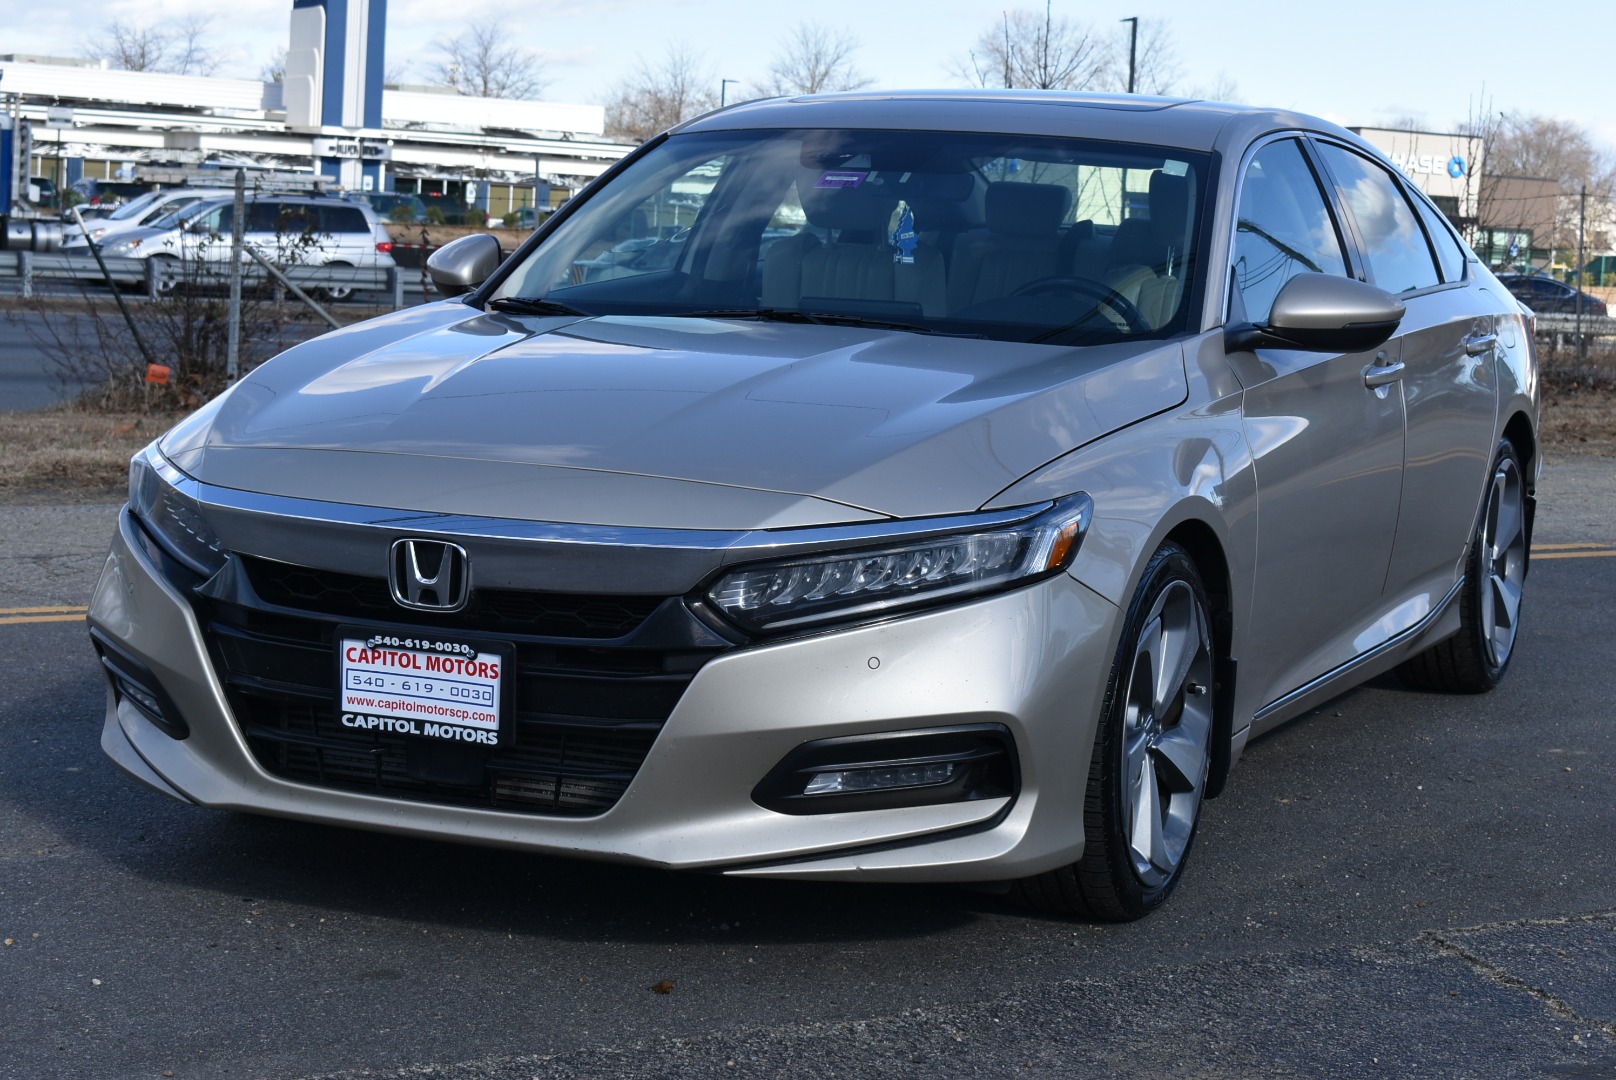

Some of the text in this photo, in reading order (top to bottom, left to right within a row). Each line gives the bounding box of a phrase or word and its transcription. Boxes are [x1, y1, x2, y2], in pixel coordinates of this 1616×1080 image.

[1384, 151, 1446, 175] HASE
[374, 635, 469, 654] 540-619-0030
[346, 647, 499, 679] CAPITOL MOTORS
[346, 695, 496, 723] www.capitolmotorscp.com
[341, 713, 498, 745] CAPITOL MOTORS
